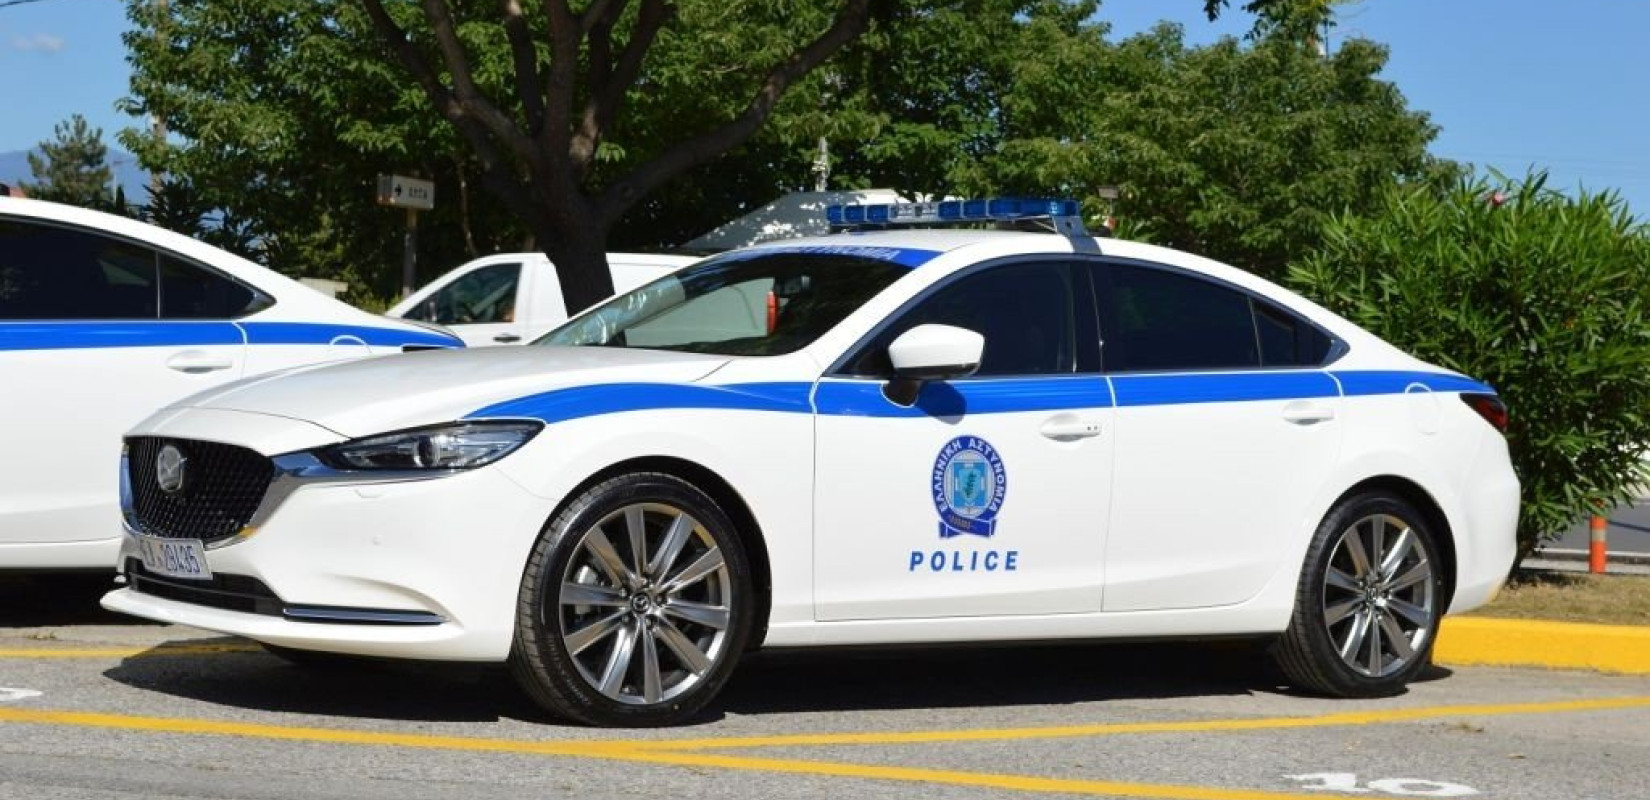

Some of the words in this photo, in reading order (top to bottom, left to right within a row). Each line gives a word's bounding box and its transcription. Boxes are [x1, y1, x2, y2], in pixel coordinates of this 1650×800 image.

[934, 439, 961, 512] ΕΛΛΗΝΙΚΗ
[969, 438, 1005, 511] ΑΣΤΥΝΟΜΙΑ
[909, 551, 1019, 572] POLICE
